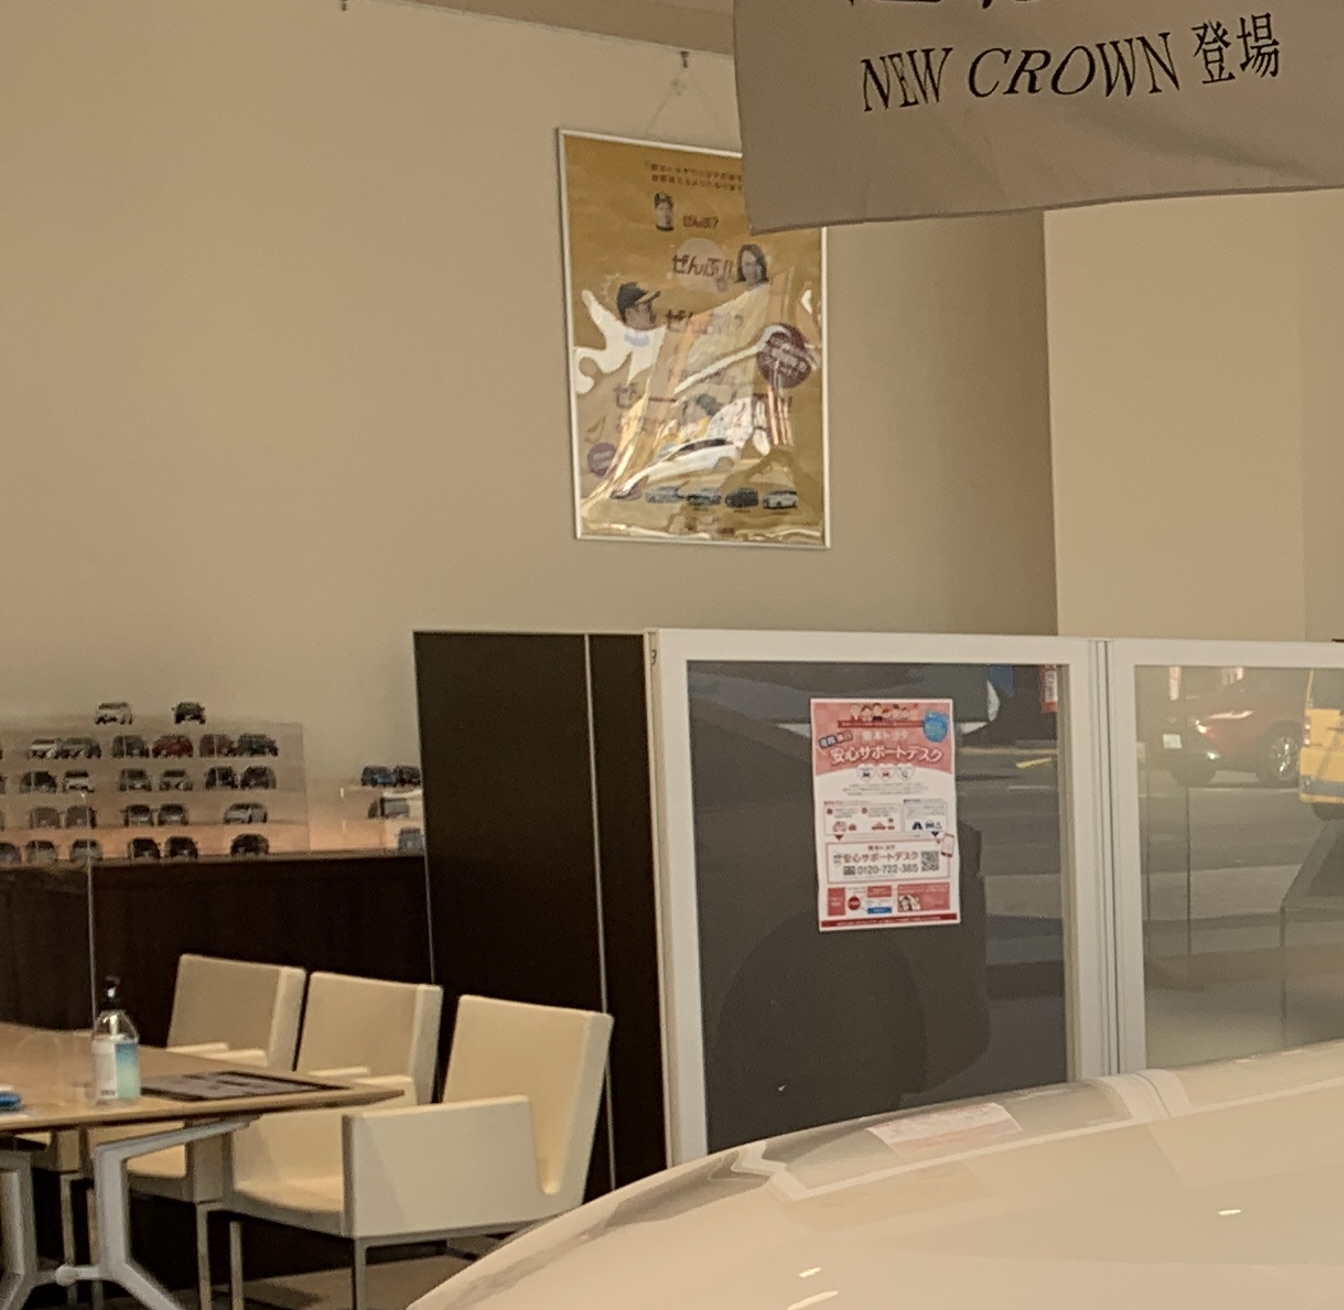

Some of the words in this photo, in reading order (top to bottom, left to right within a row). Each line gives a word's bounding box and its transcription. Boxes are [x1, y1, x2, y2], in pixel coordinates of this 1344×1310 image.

[860, 47, 954, 112] NEW
[967, 32, 1181, 98] CROWN
[1191, 12, 1281, 85] 登場
[830, 745, 943, 764] 安心サポートデスク
